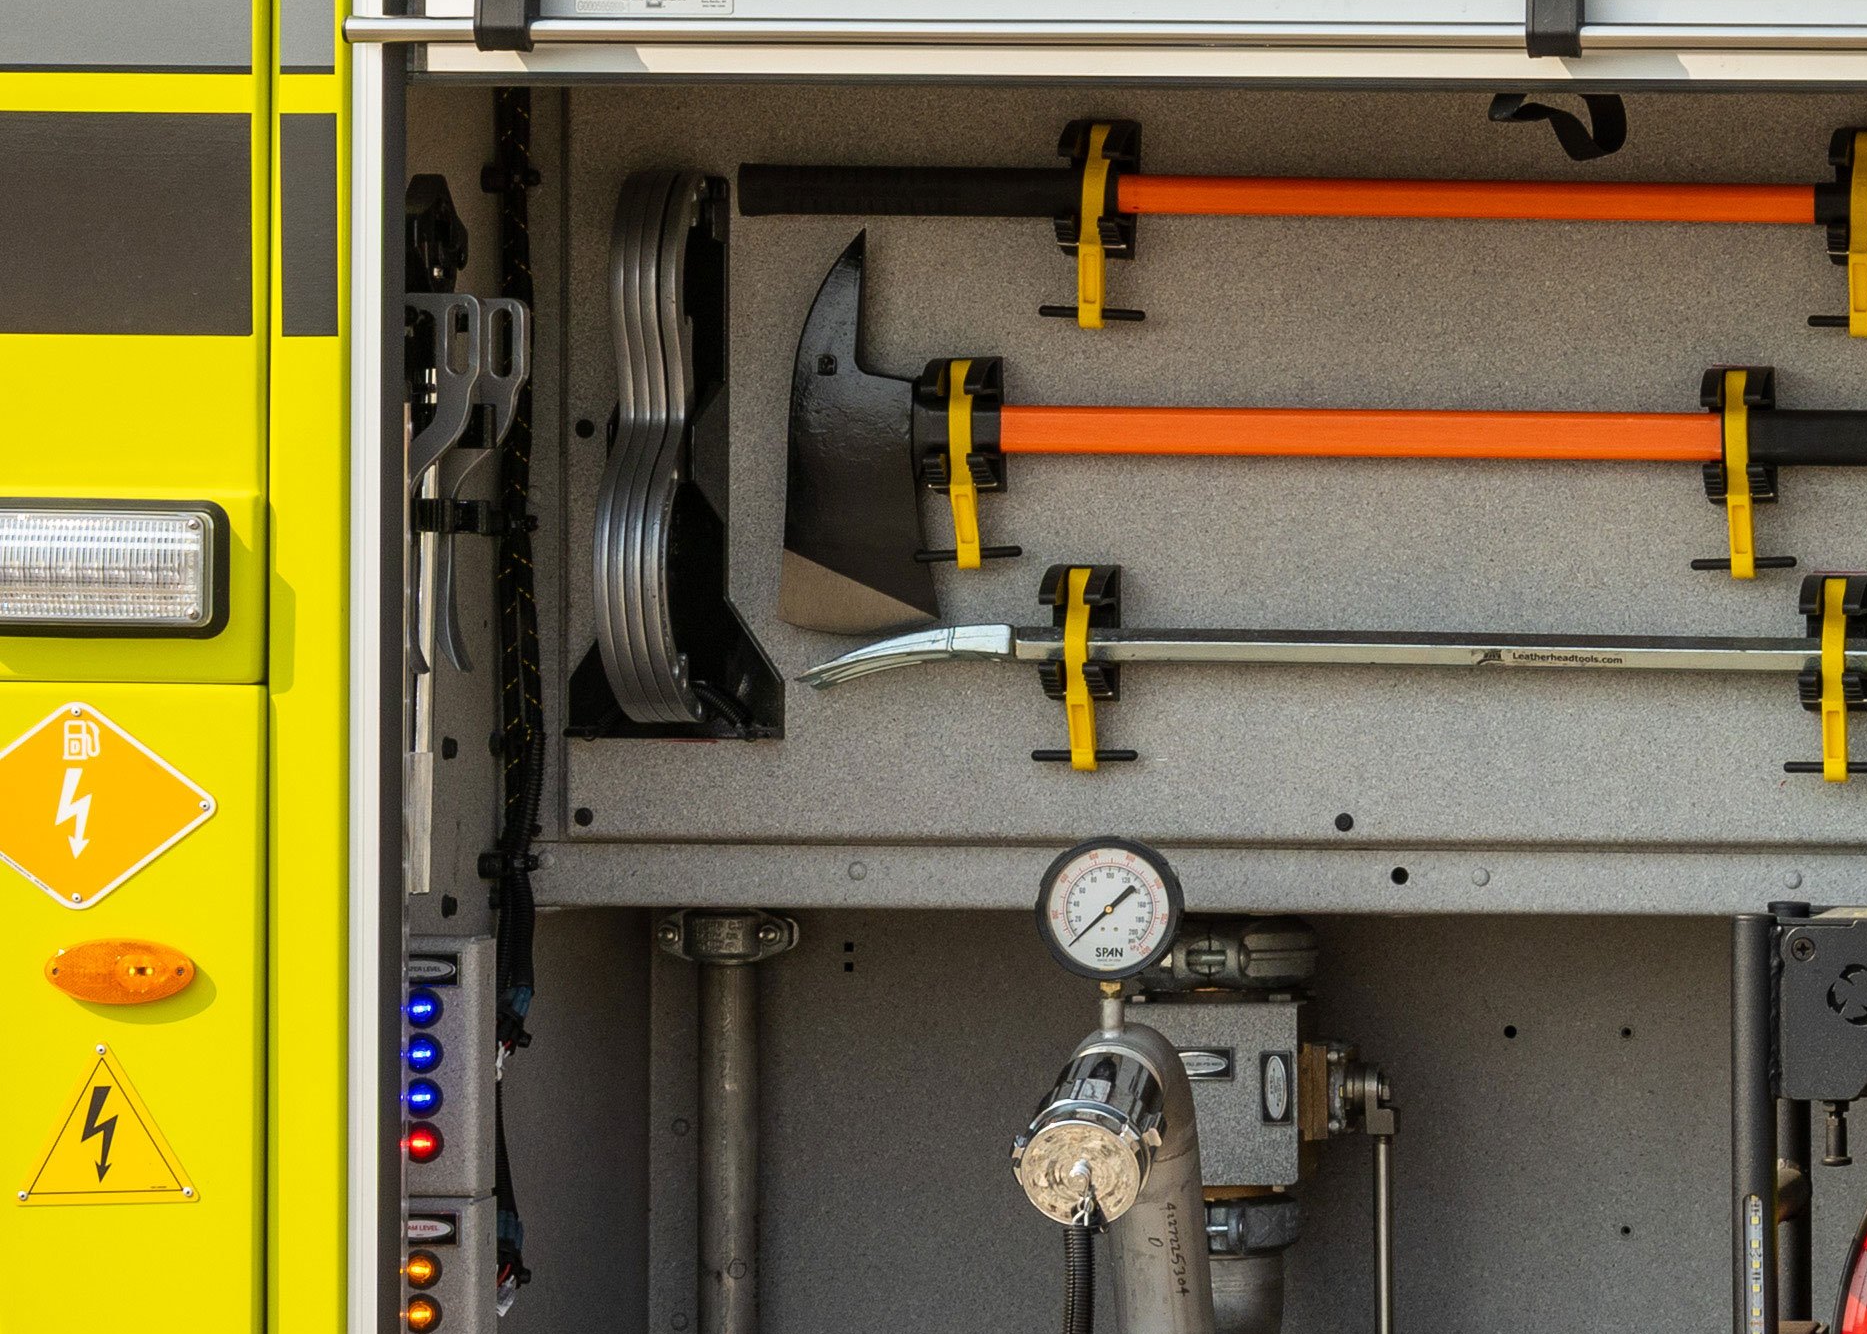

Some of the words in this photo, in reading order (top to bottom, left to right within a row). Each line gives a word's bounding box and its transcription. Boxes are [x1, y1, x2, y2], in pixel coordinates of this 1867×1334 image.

[1512, 652, 1623, 664] Leatherheadtools.com
[1121, 875, 1131, 884] 120
[1095, 947, 1124, 957] SPAN
